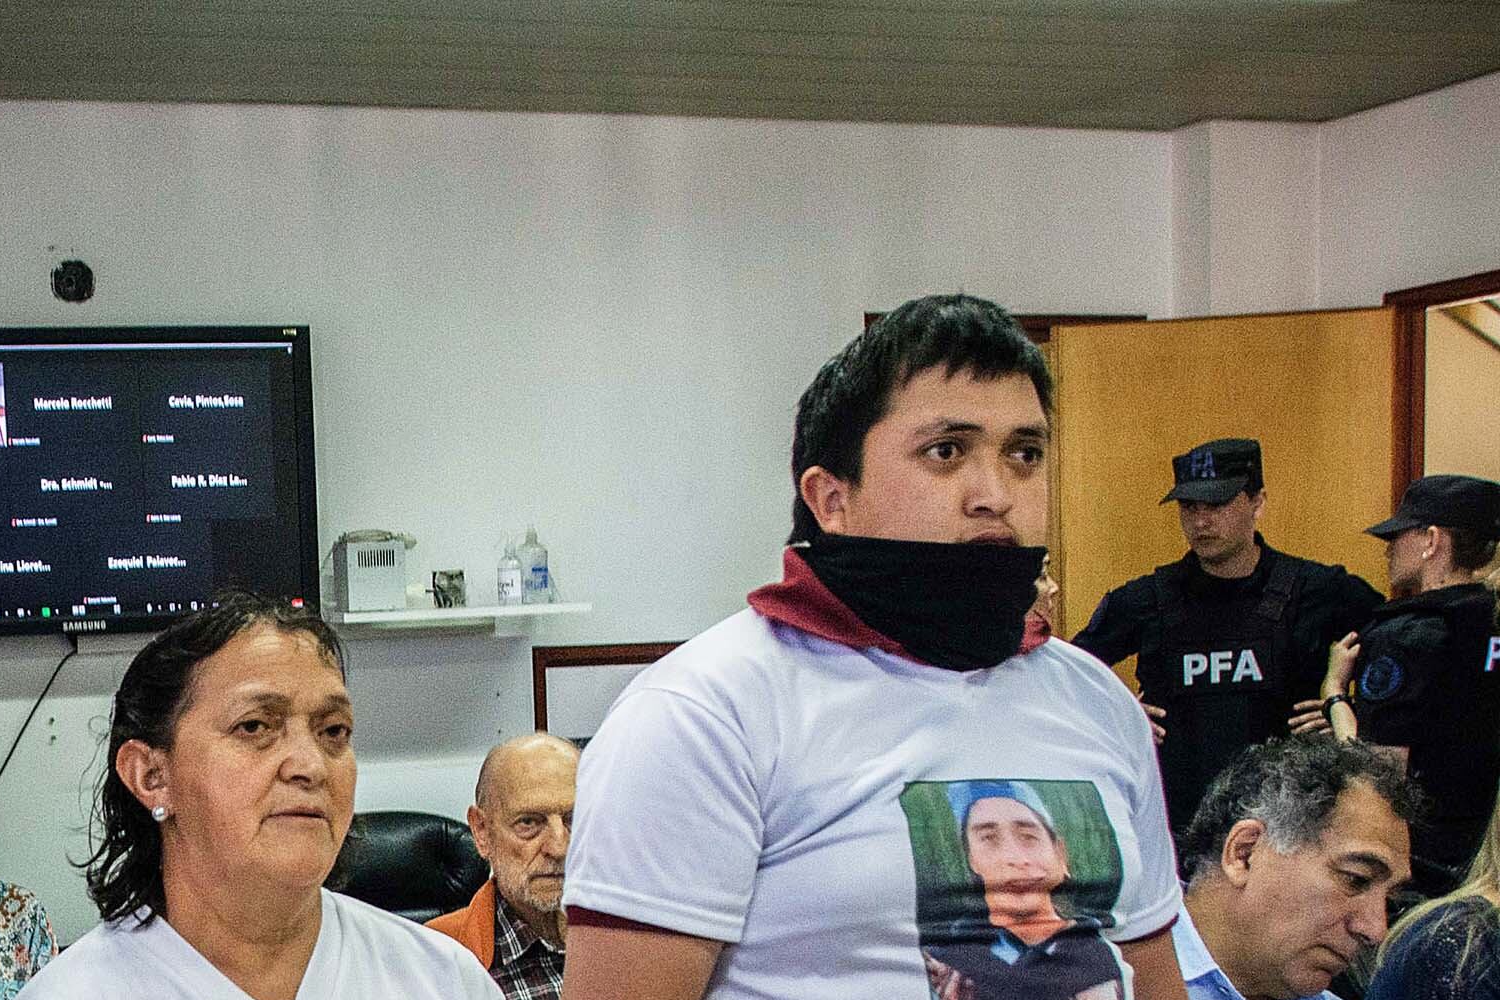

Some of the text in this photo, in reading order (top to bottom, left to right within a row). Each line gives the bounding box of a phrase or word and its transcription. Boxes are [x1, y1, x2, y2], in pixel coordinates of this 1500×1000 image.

[61, 477, 98, 491] Schmidt
[172, 474, 196, 488] Pablo
[108, 555, 144, 571] Ezequiel
[62, 619, 106, 632] SAMSUNG
[1183, 649, 1263, 686] PFA
